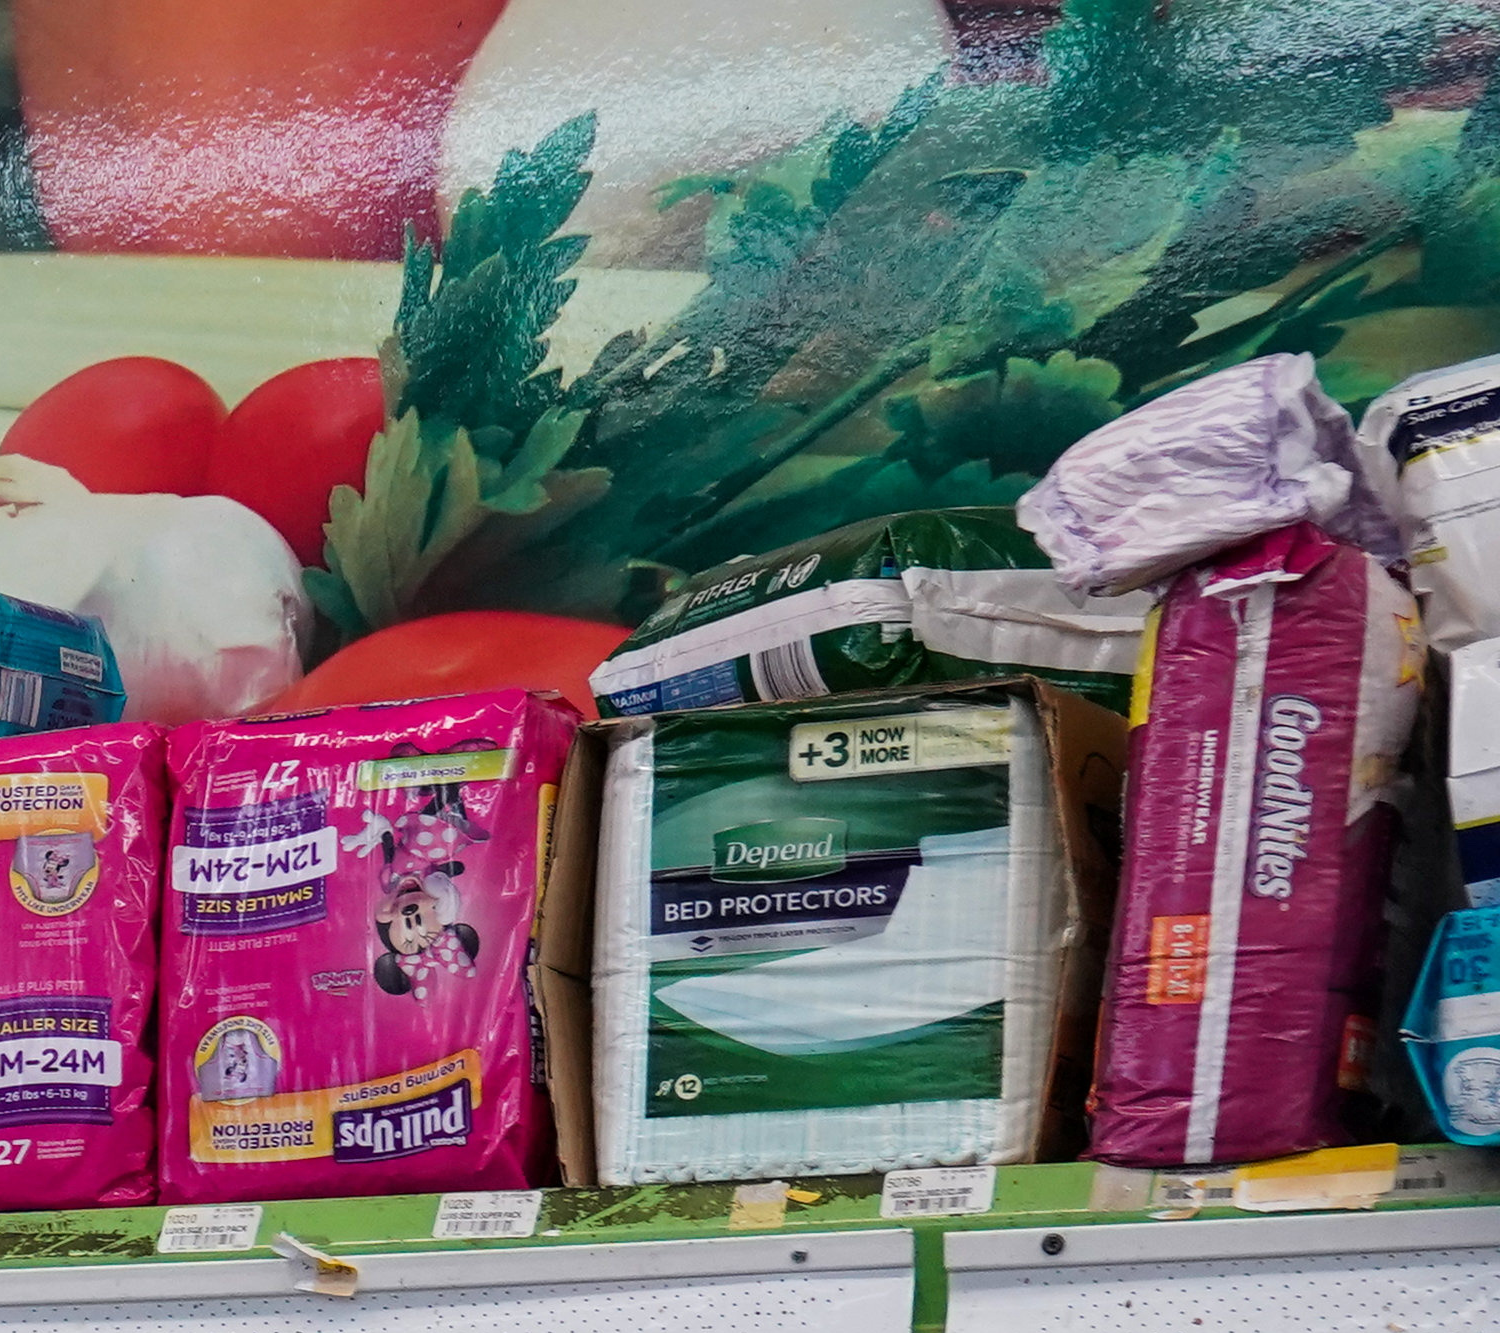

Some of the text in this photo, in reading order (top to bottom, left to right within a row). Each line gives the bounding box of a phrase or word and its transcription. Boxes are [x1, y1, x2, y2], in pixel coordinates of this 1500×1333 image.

[689, 569, 766, 609] FIT-FLEX
[797, 726, 906, 769] +3 NOW
[860, 744, 910, 764] MORE
[262, 759, 301, 791] 27
[1192, 729, 1220, 847] UNDERWEAR
[1248, 693, 1323, 902] GoodNites
[189, 840, 321, 883] 12M-24M
[726, 833, 834, 871] Depend
[196, 886, 314, 914] SMALLER SIZE
[663, 885, 886, 924] BED PROTECTORS
[1171, 923, 1195, 960] 8-14
[28, 982, 51, 993] PLUS
[60, 1017, 99, 1034] SIZE
[342, 1058, 466, 1105] Learning Designs
[678, 1078, 699, 1094] 12
[212, 1120, 314, 1138] PROTECTION
[340, 1084, 466, 1155] Pull-Ups
[237, 1133, 315, 1150] TRUSTED
